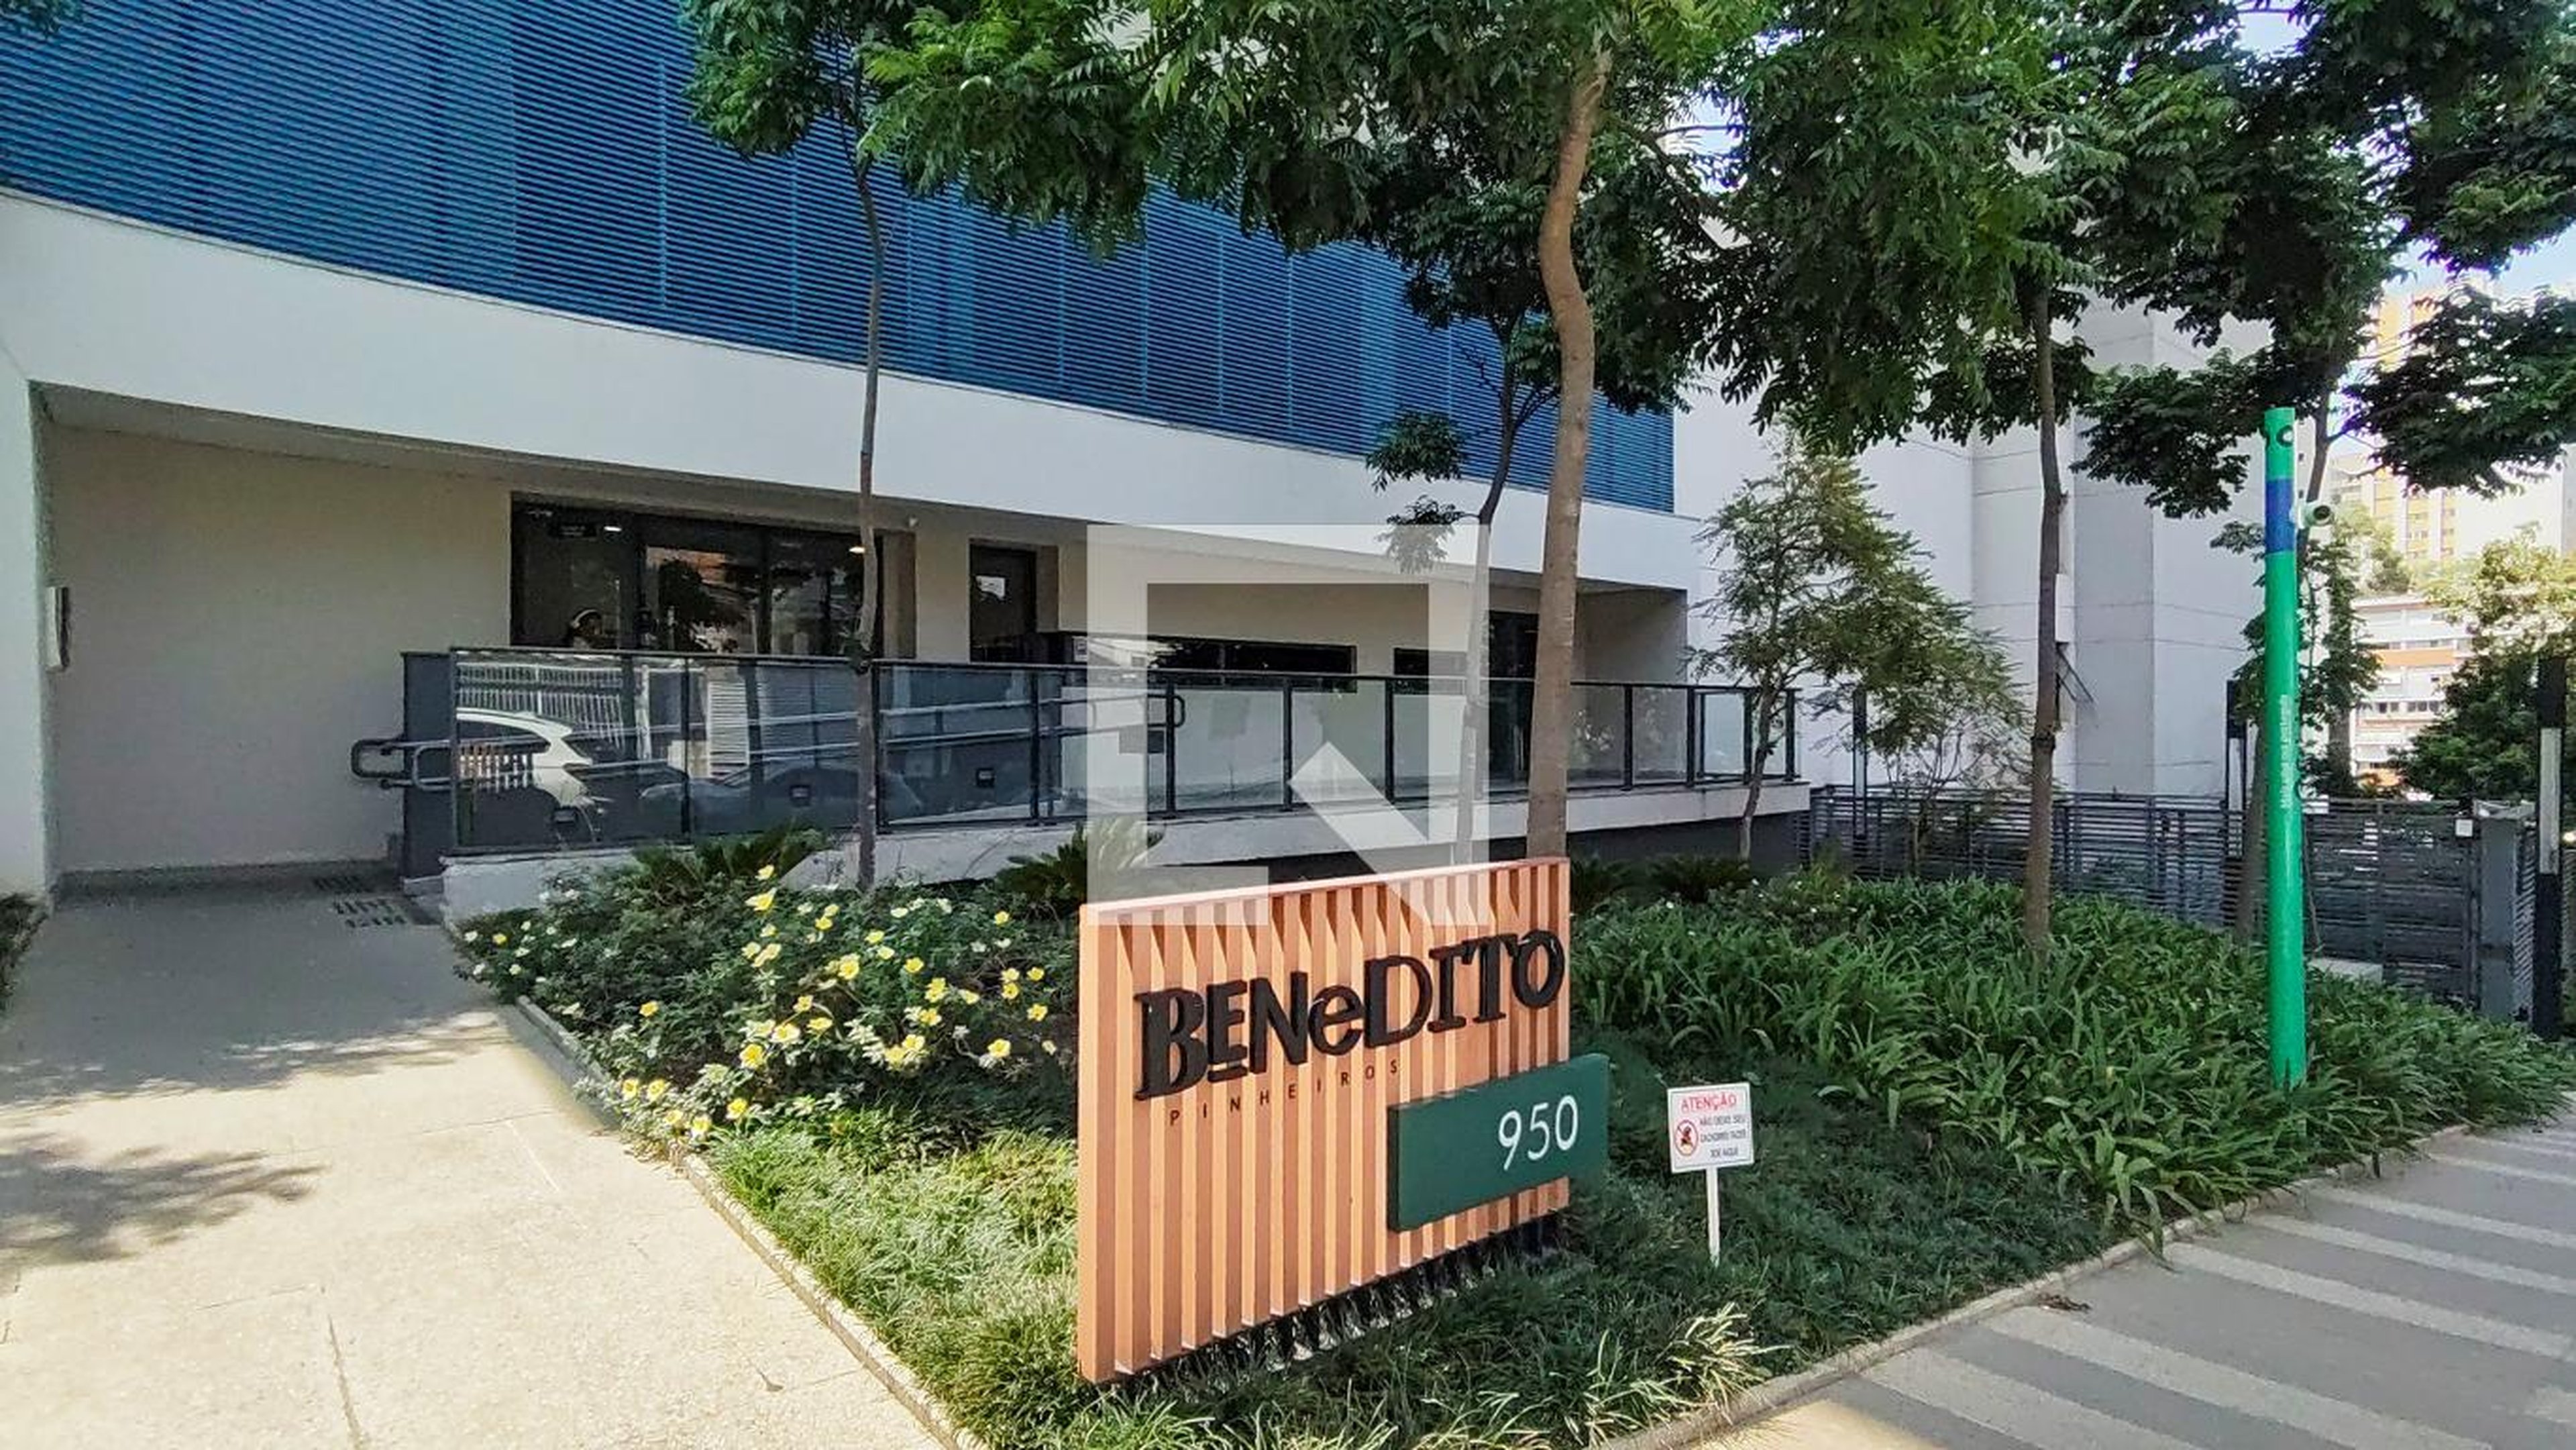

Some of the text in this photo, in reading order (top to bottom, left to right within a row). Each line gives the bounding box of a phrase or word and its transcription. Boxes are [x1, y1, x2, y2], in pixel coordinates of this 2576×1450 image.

[1169, 1058, 1398, 1126] PINHEIROS
[1680, 1092, 1737, 1112] ATENÇÃO
[1498, 1094, 1578, 1172] 950
